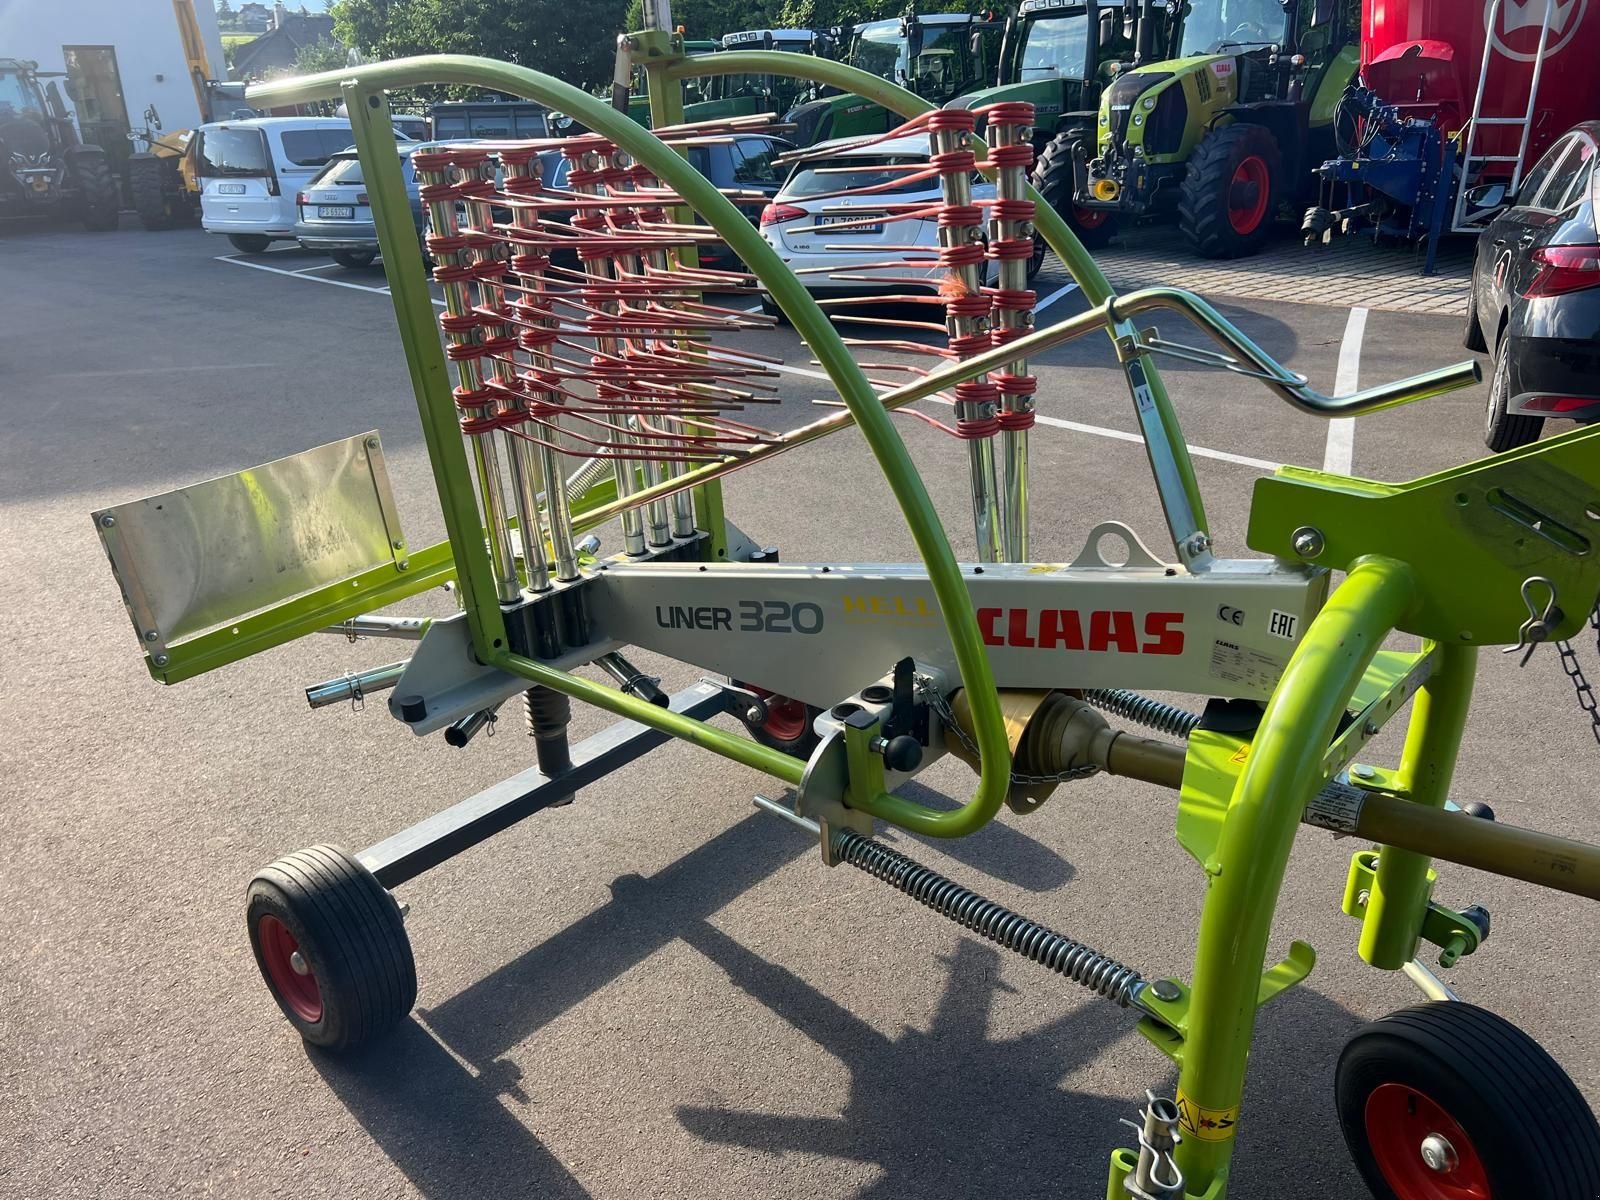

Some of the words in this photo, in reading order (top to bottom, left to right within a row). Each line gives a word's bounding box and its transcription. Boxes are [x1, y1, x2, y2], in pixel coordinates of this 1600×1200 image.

[655, 605, 733, 631] LINER
[738, 600, 824, 635] 320
[842, 594, 937, 617] HELL
[976, 607, 1185, 656] CLAAS
[1270, 612, 1296, 638] EAC
[1215, 639, 1240, 651] CLAAS
